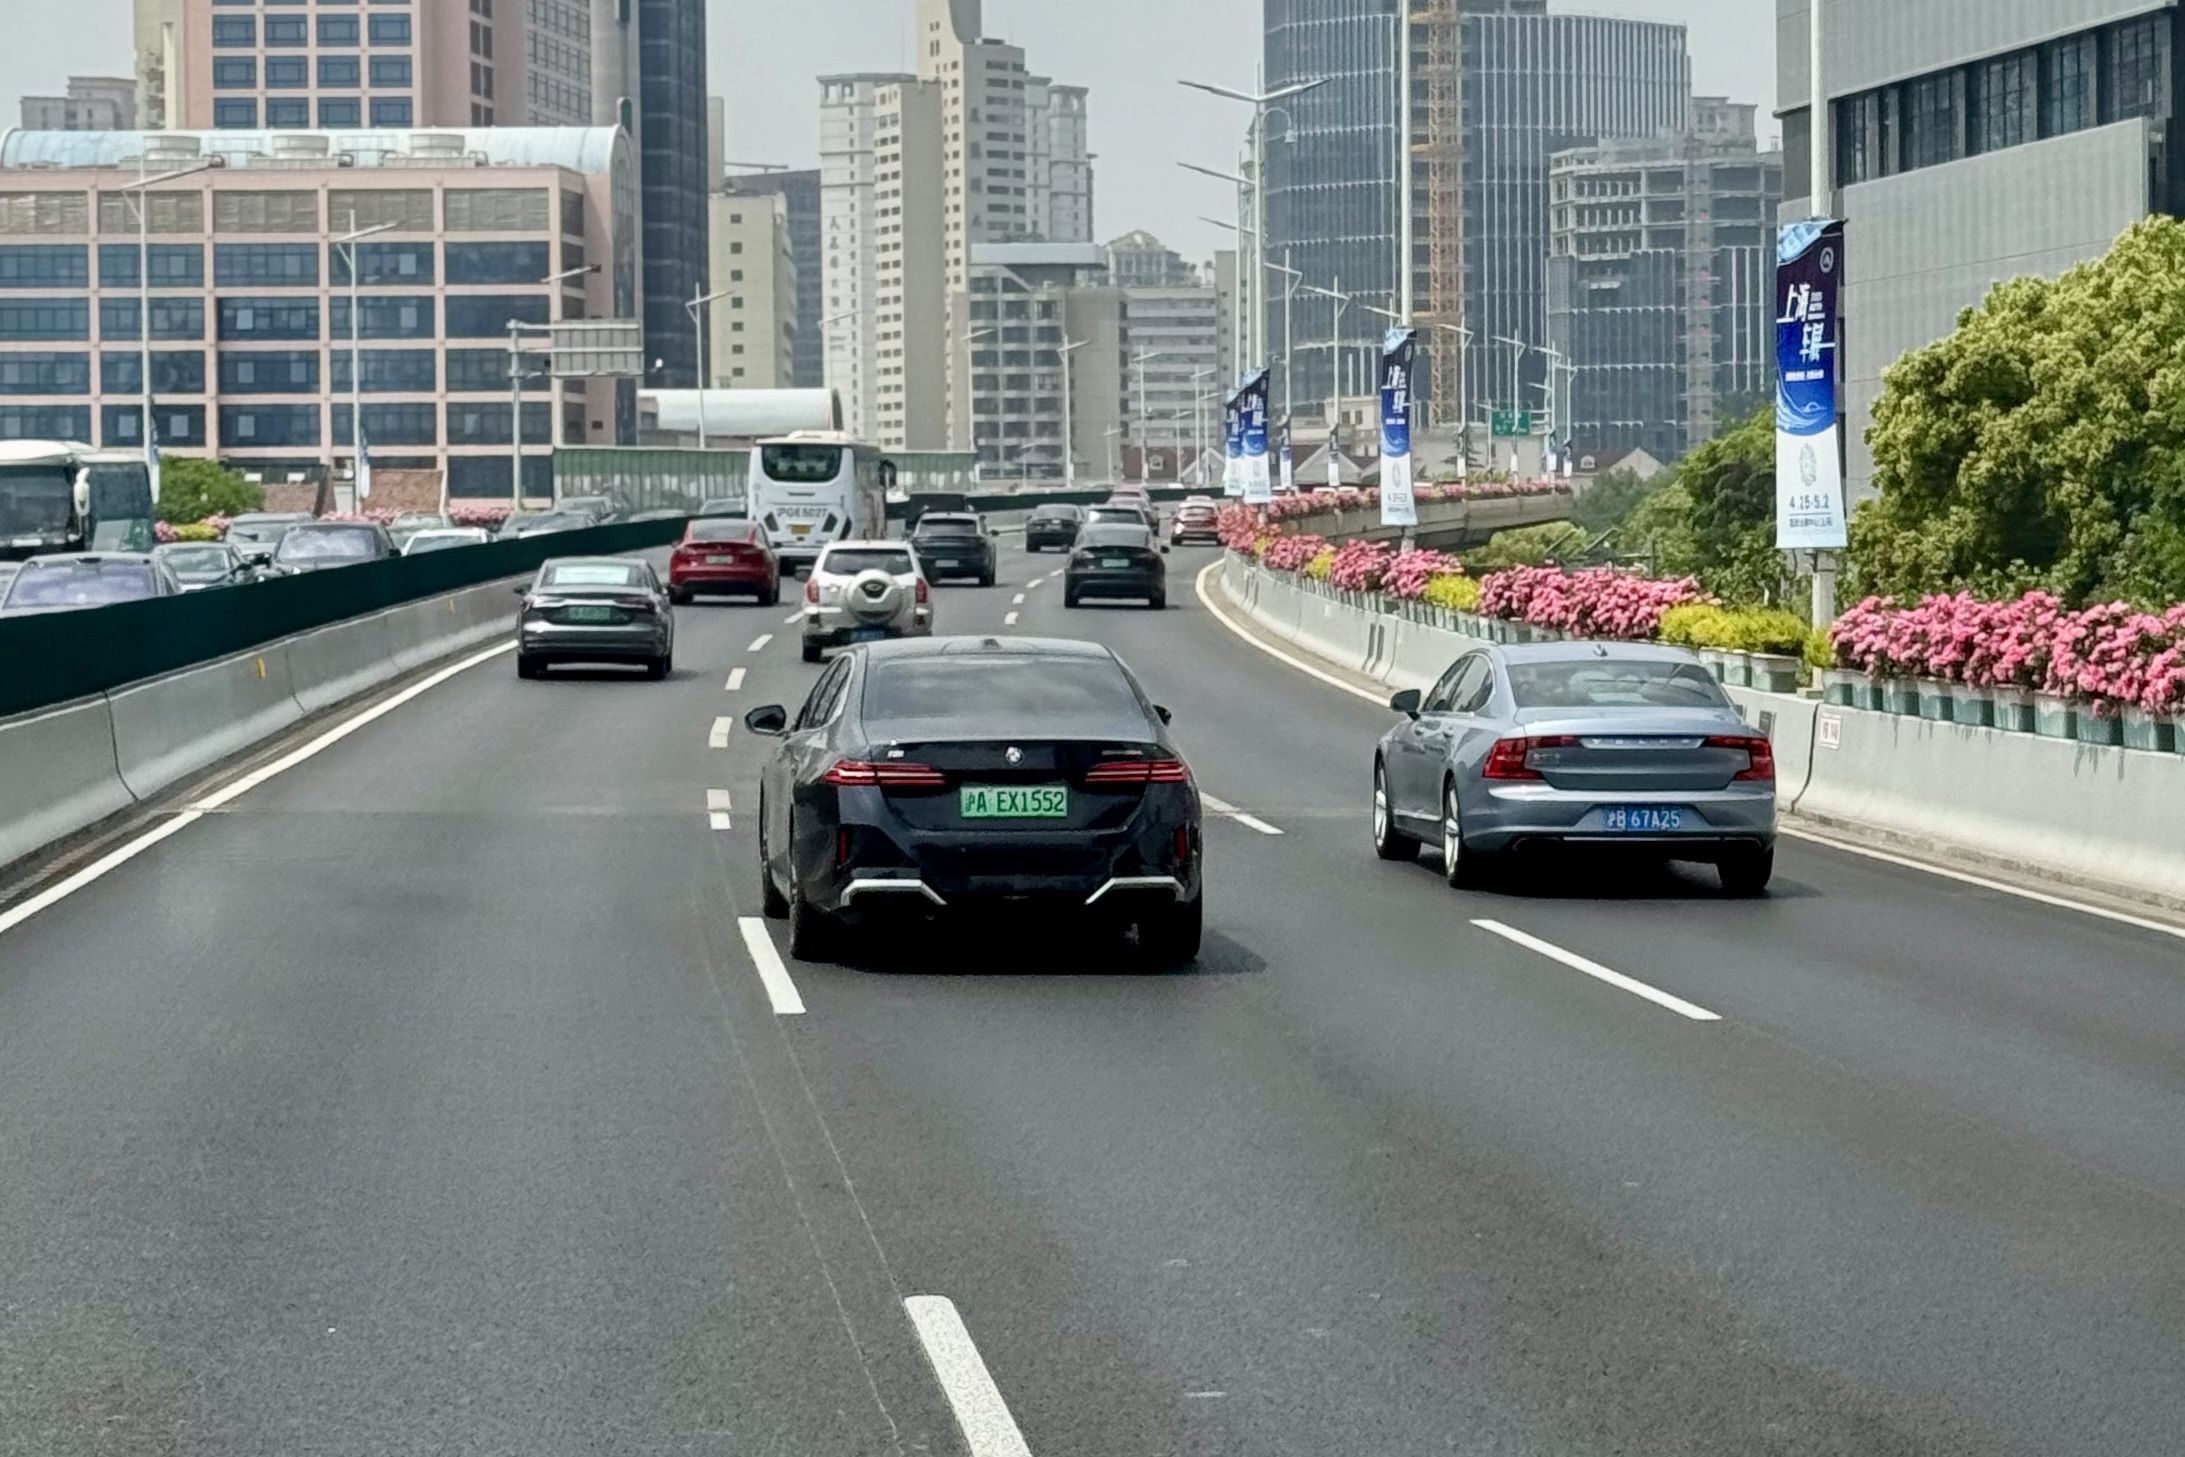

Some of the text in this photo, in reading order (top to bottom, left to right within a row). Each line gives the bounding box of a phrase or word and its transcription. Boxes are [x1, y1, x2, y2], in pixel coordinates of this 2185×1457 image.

[1776, 282, 1811, 323] 上海
[996, 791, 1065, 813] EX1552
[1631, 809, 1681, 828] 67A25
